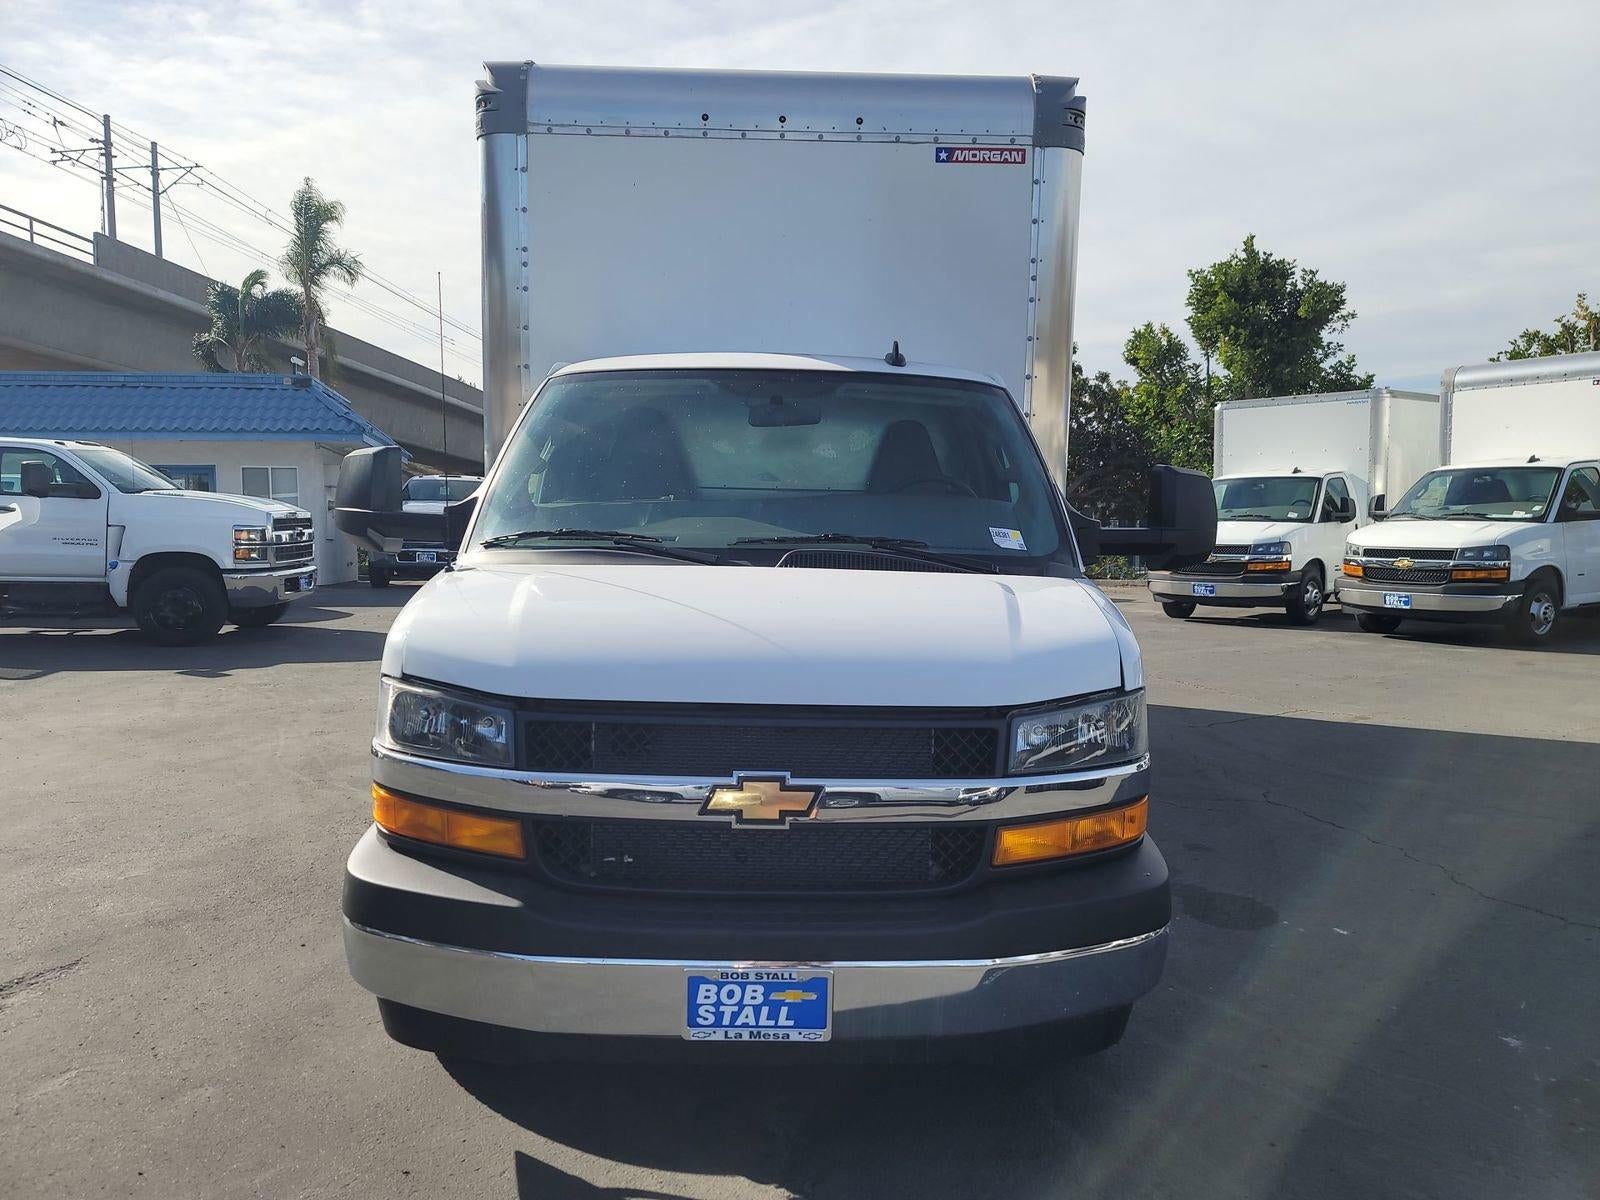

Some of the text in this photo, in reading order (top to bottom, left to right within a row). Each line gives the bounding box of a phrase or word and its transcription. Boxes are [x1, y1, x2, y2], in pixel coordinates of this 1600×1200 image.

[952, 150, 1023, 162] MORGAN
[720, 972, 797, 981] BOB STALL
[696, 983, 765, 1005] BOB
[696, 1005, 795, 1026] STALL
[724, 1030, 790, 1040] La Mesa
